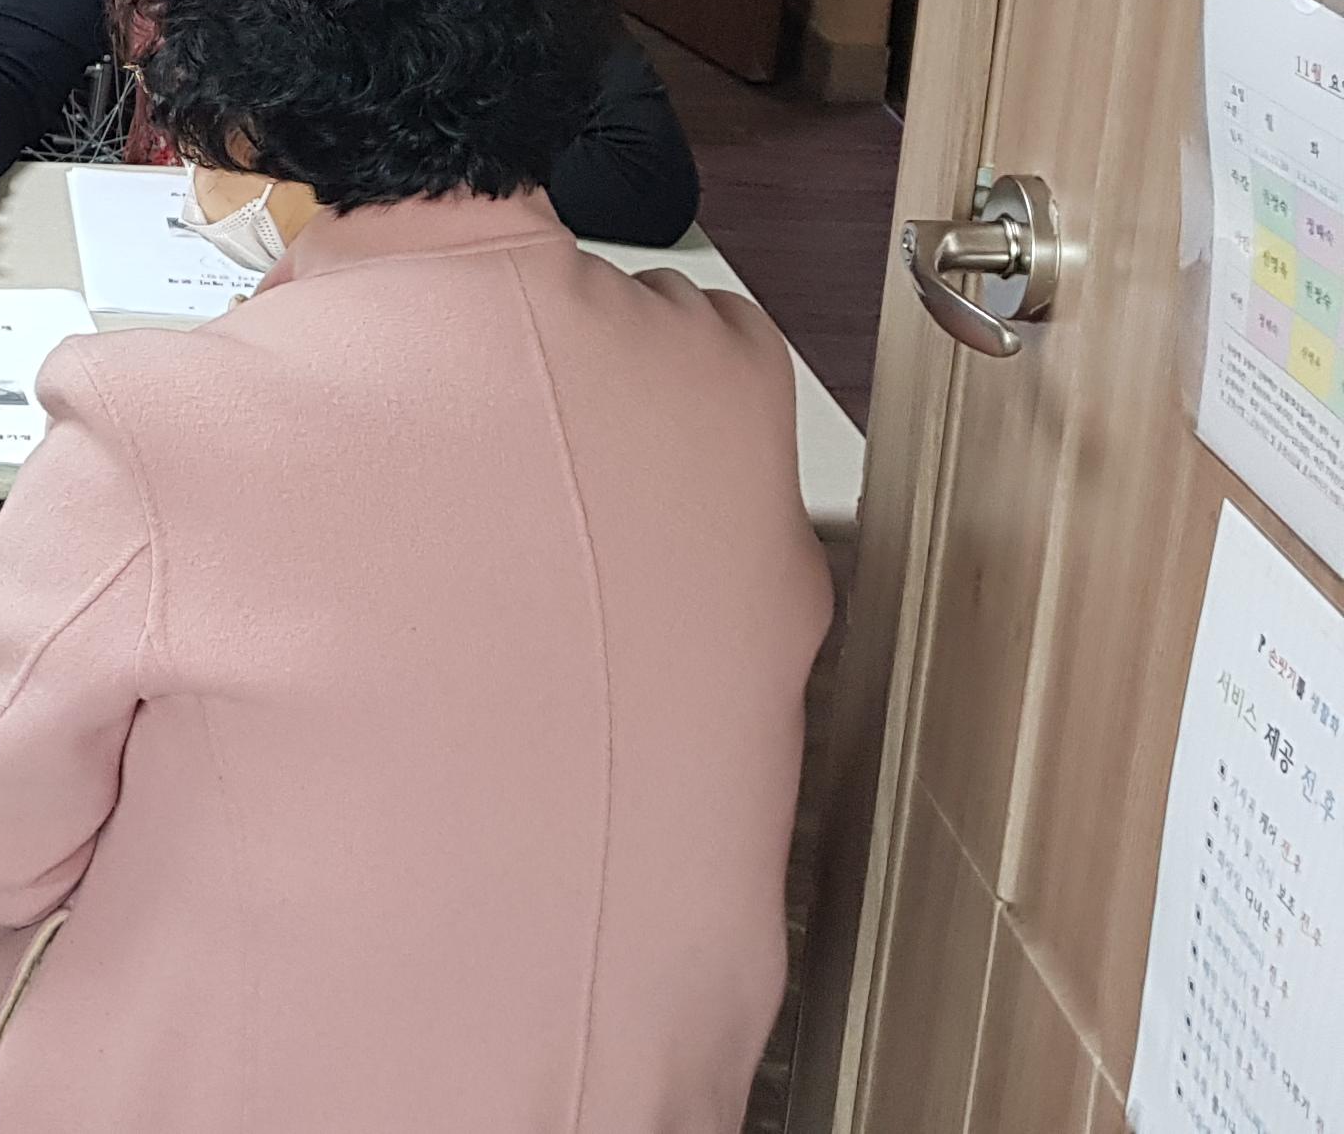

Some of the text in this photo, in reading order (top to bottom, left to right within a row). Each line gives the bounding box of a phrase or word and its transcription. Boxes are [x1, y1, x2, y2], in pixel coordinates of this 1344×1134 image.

[1329, 74, 1344, 92] 요
[1217, 669, 1257, 732] 서비스
[1264, 723, 1295, 774] 제공
